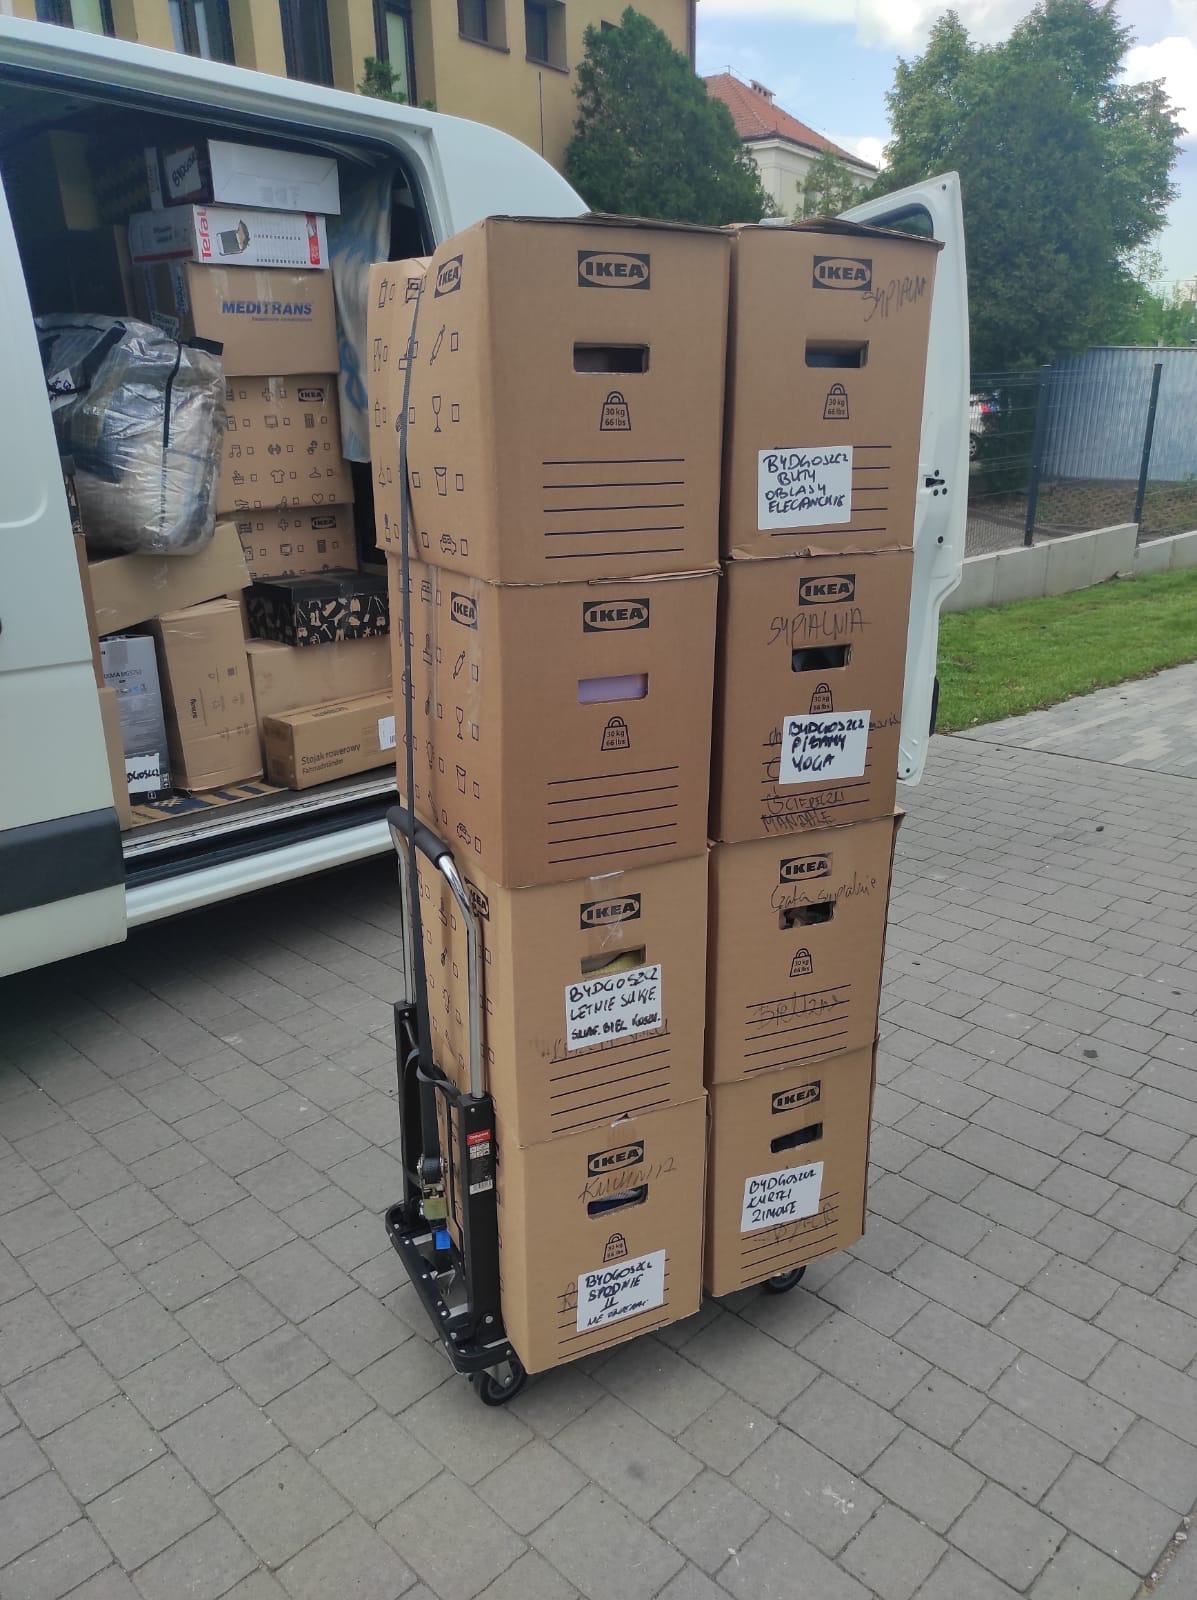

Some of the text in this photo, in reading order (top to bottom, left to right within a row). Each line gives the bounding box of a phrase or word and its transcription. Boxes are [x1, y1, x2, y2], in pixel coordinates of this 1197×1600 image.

[196, 208, 212, 258] Tefal
[437, 265, 460, 288] IKEA
[585, 261, 645, 279] IKEA
[818, 266, 868, 281] IKEA
[222, 301, 313, 316] MEDITRANS
[300, 391, 322, 399] IKEA
[604, 407, 625, 417] 30 kg
[604, 417, 626, 426] 66 lbs
[777, 469, 816, 486] BUTY
[804, 582, 851, 597] IKEA
[453, 602, 475, 620] IKEA
[589, 606, 645, 623] IKEA
[606, 729, 625, 738] 30 kg
[301, 743, 361, 766] Stojak rowerowy
[791, 753, 836, 773] YOGA
[785, 860, 828, 876] IKEA
[586, 902, 636, 920] IKEA
[570, 996, 616, 1021] LETNIE
[776, 1087, 818, 1107] IKEA
[593, 1148, 640, 1169] IKEA
[746, 1188, 792, 1209] KURTKI
[751, 1200, 797, 1223] ZIMOWE
[588, 1273, 644, 1302] SPODNIE
